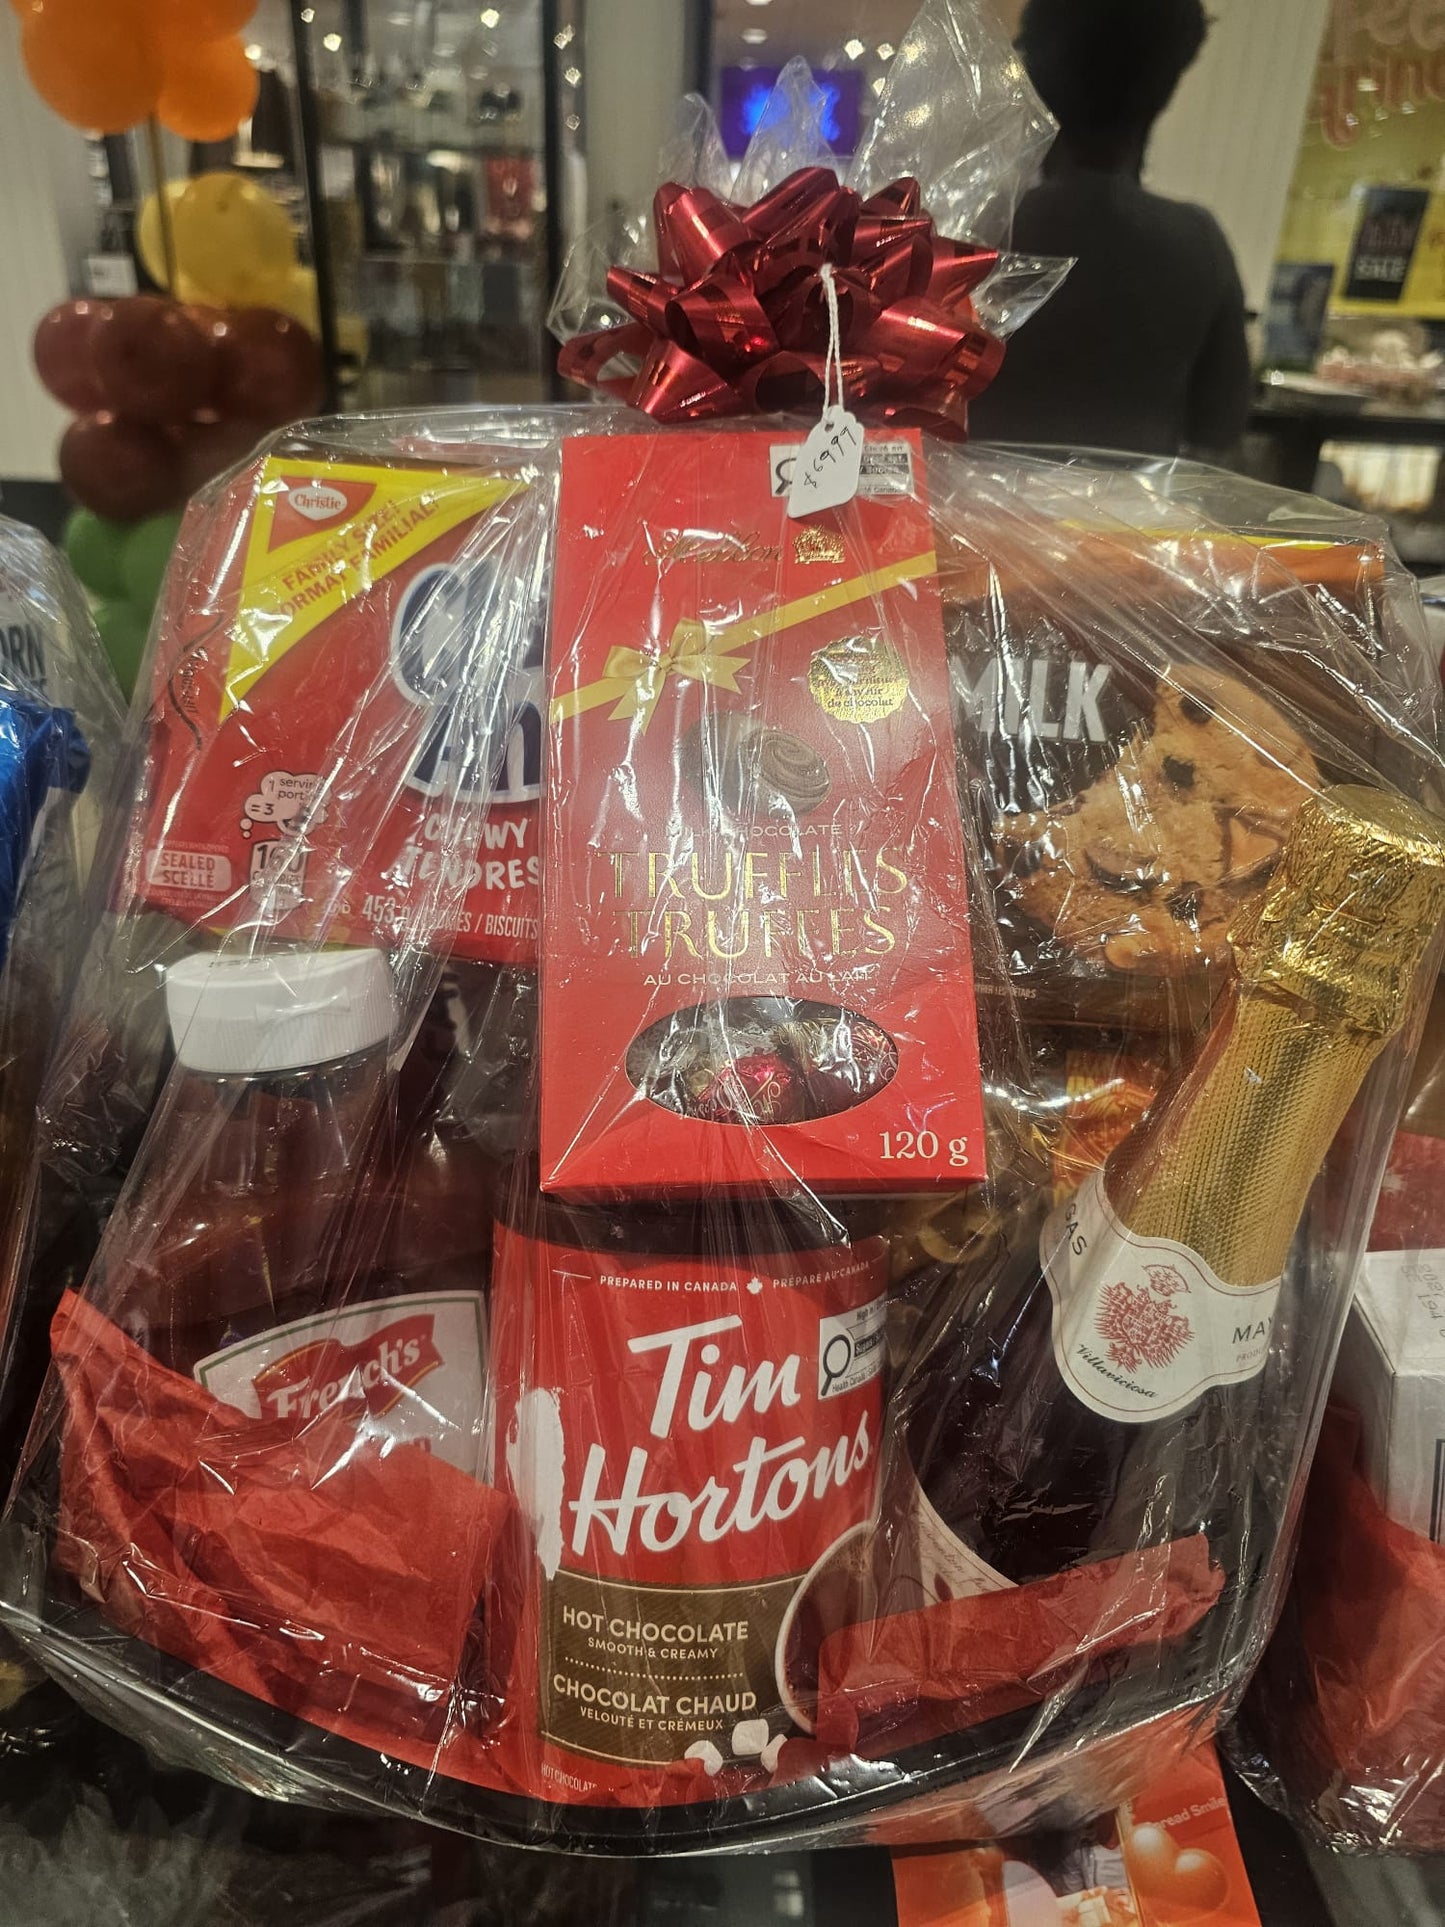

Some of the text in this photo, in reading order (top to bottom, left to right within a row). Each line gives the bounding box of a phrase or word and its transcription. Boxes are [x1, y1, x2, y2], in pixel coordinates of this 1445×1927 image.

[294, 493, 341, 509] Christie
[282, 538, 349, 591] FAMILY
[278, 570, 348, 616] ORMAT
[949, 654, 1113, 743] MILK
[263, 803, 275, 816] 3
[161, 851, 216, 872] SEALED
[597, 848, 908, 901] TRUFFLES
[362, 894, 397, 924] 453
[485, 913, 540, 940] BISCUITS
[612, 905, 896, 960] TRUFFES
[643, 972, 672, 987] AU
[677, 972, 791, 987] CHOCOLAT
[795, 971, 823, 986] AU
[879, 1130, 969, 1167] 120 g
[600, 1274, 738, 1292] PREPARED IN CANADA
[627, 1314, 802, 1439] Tim
[1074, 1343, 1159, 1399] Villaviciosa
[569, 1410, 871, 1557] Hortons
[563, 1605, 749, 1643] HOT CHOCOLATE
[588, 1637, 718, 1660] SMOOTH & CREAMY
[553, 1673, 757, 1716] CHOCOLAT CHAUD
[580, 1706, 724, 1731] VELOUTÉ ET CRÉMEUX
[541, 1762, 555, 1777] HOT
